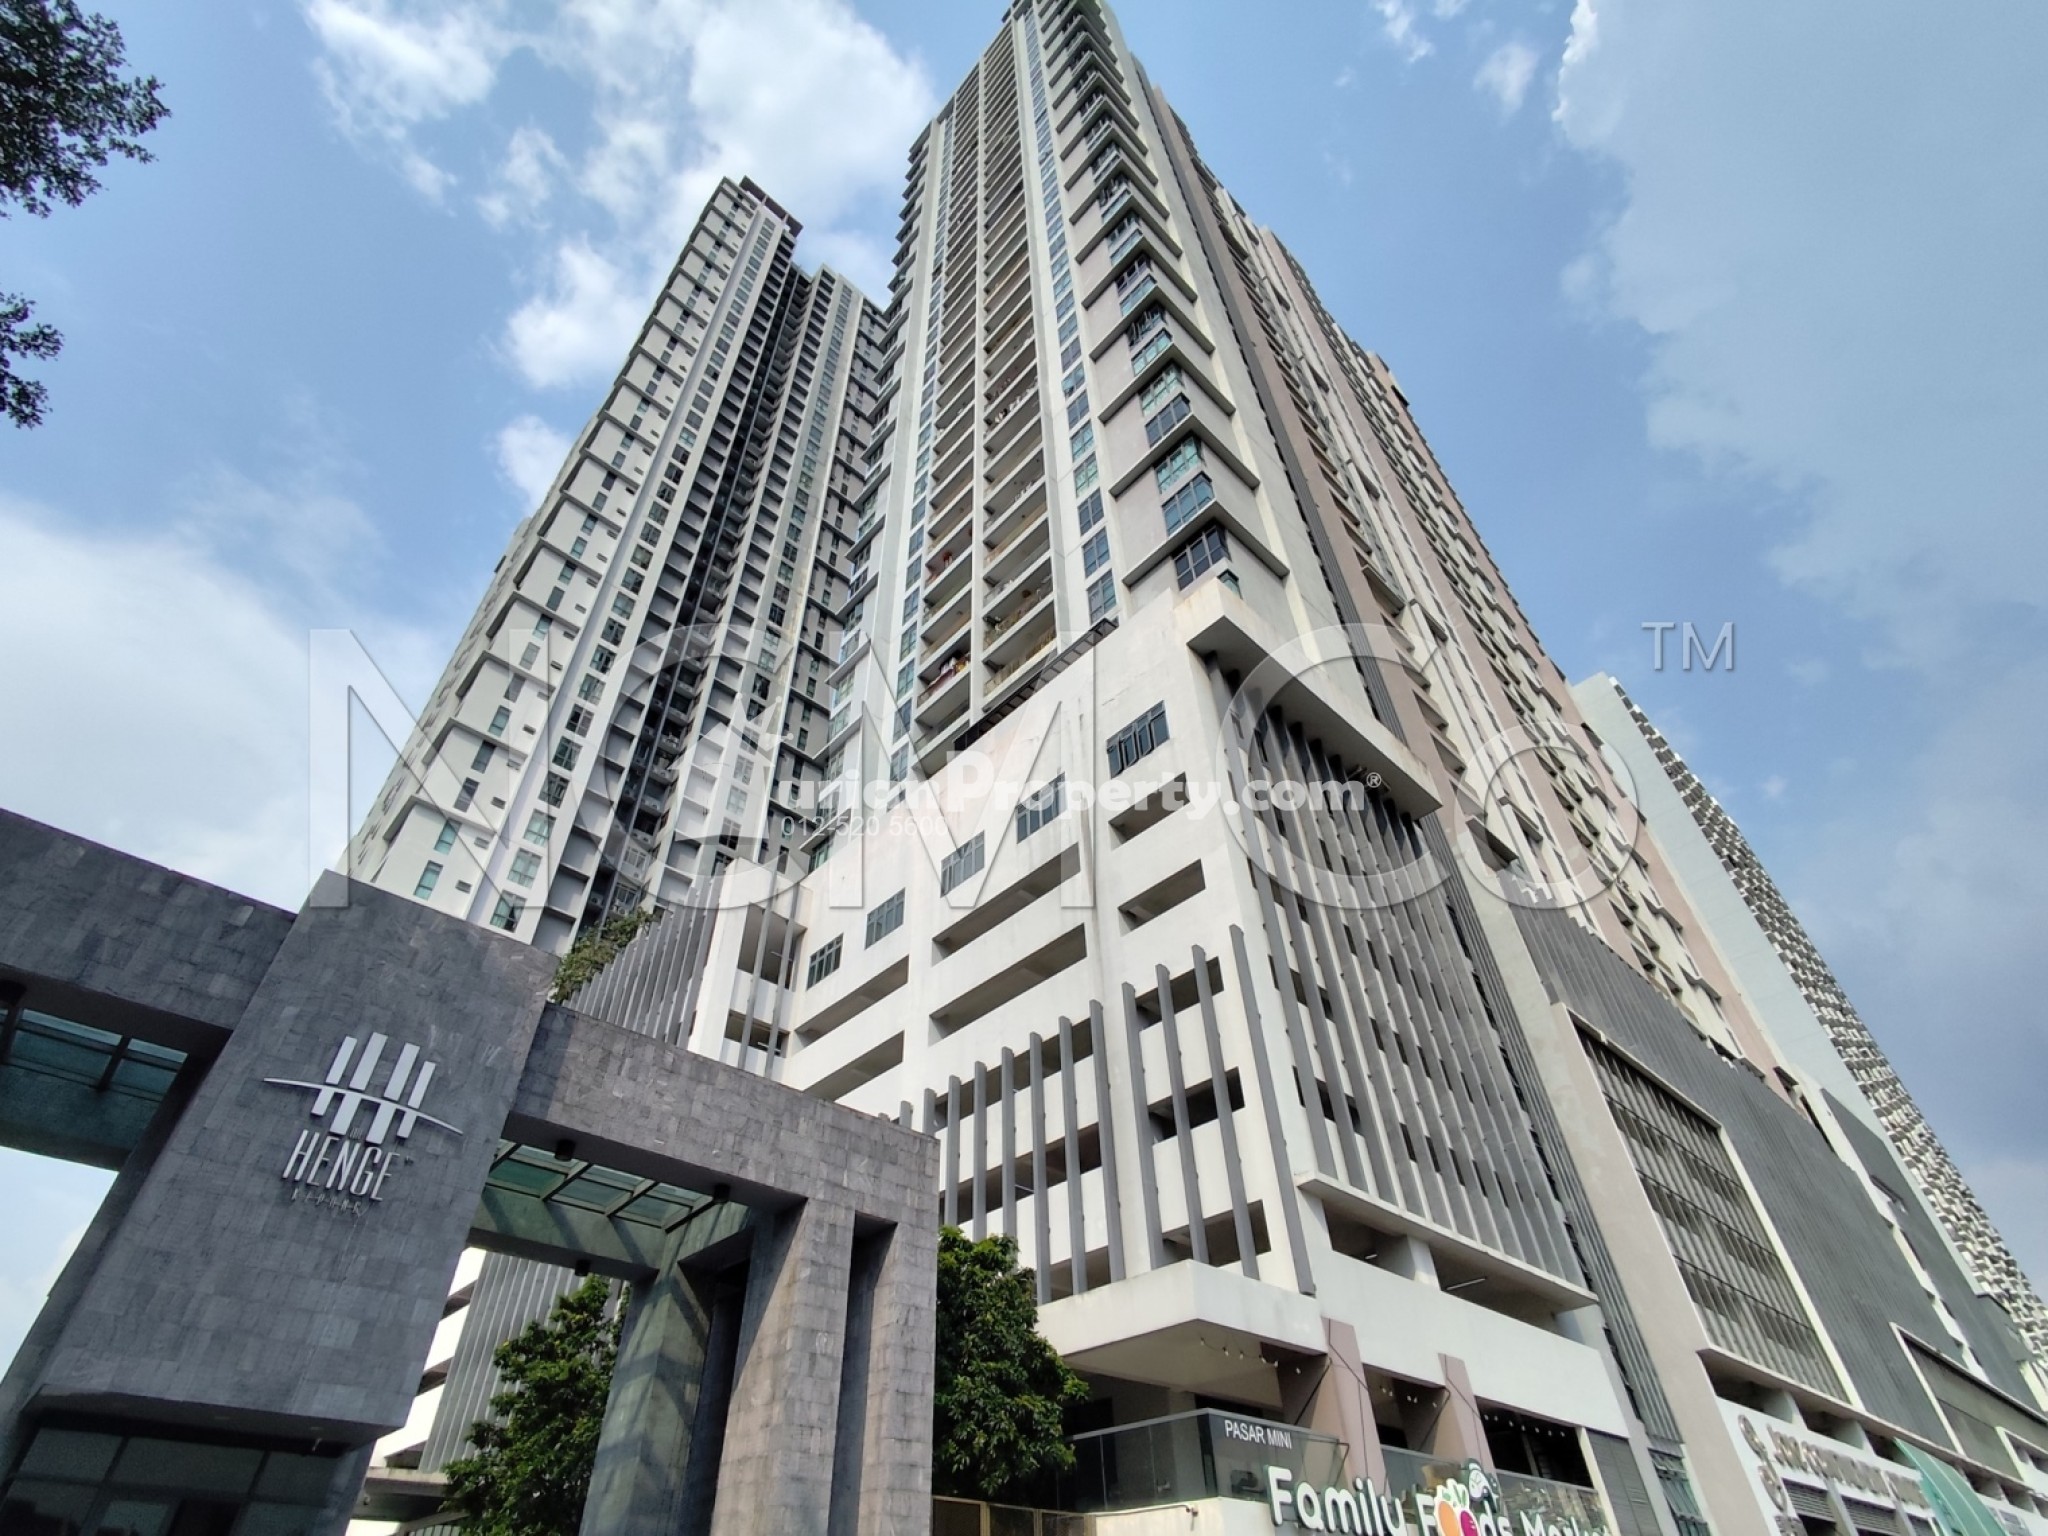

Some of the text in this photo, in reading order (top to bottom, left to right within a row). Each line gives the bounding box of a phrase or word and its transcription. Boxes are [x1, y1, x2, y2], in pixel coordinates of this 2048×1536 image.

[282, 1129, 401, 1201] HENGE
[1224, 1419, 1292, 1449] PASAR MINI
[1267, 1465, 1407, 1536] Family
